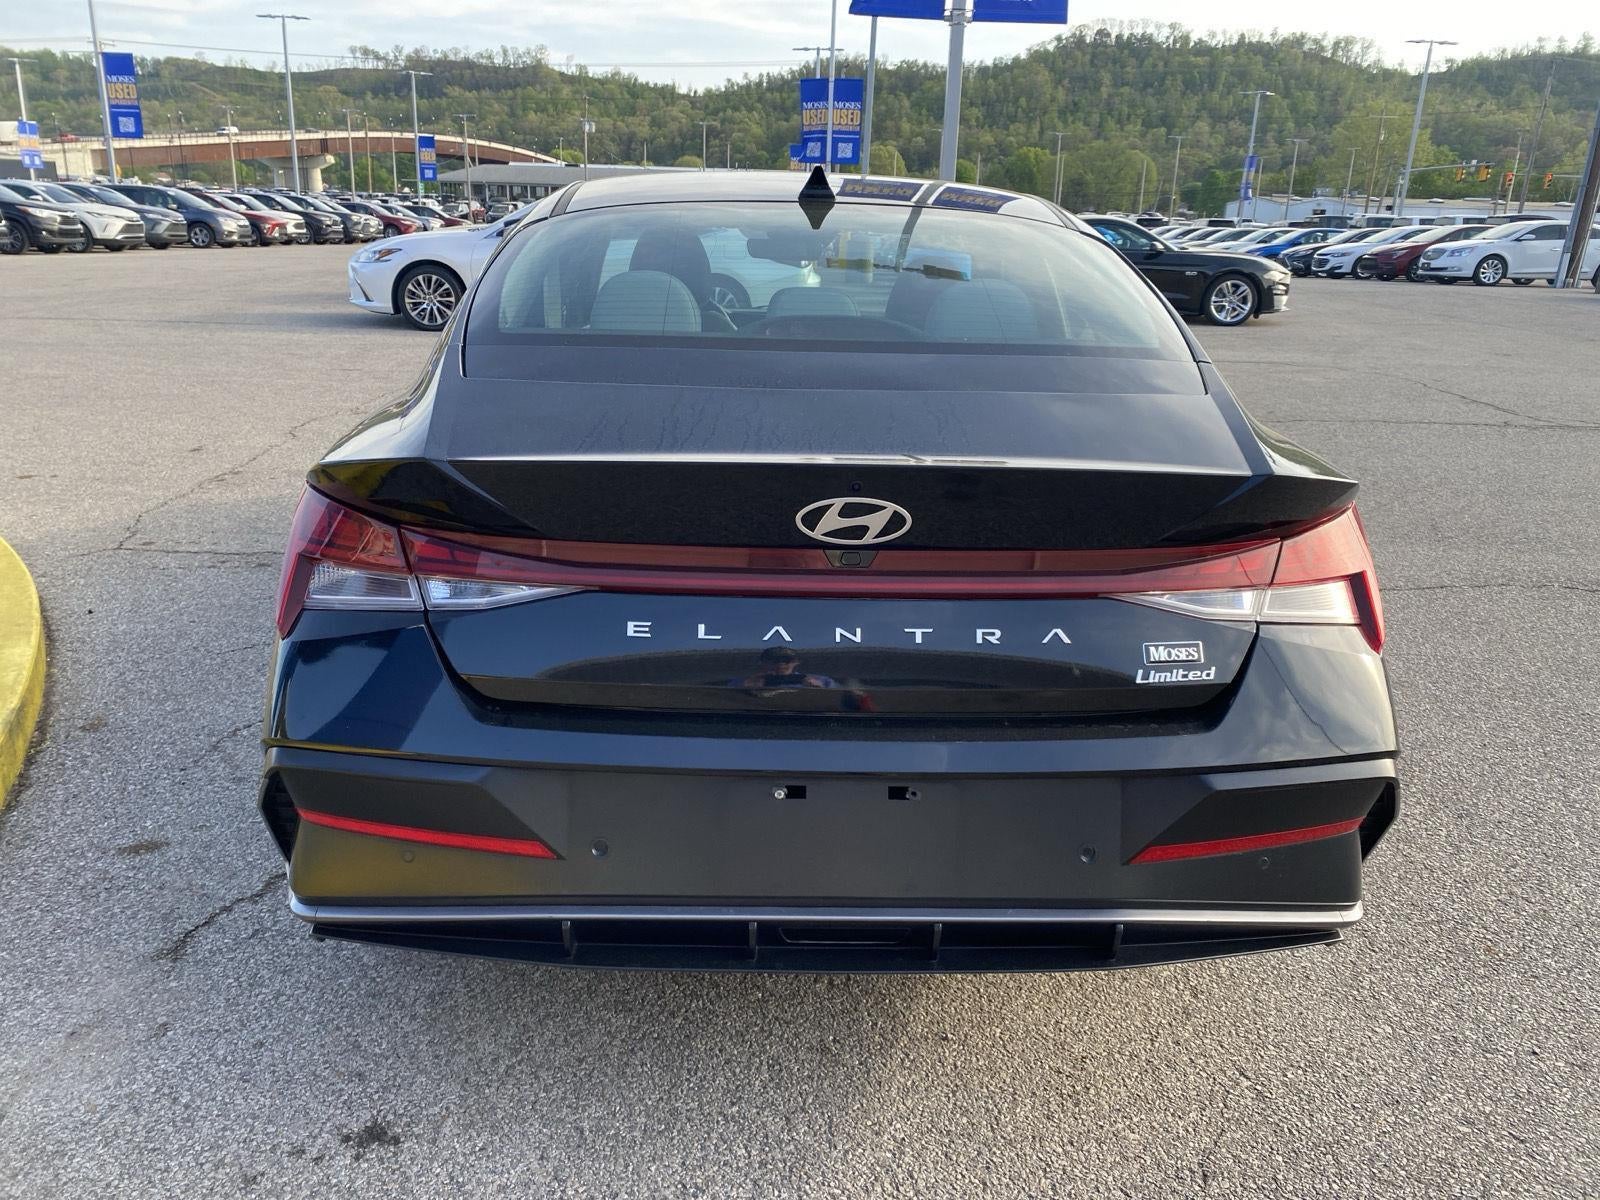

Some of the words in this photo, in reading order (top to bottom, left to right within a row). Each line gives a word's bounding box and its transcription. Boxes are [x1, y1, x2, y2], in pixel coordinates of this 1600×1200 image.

[106, 74, 135, 83] MOSES
[108, 84, 137, 99] USED
[803, 110, 828, 125] USED
[833, 110, 861, 125] USED
[626, 620, 1073, 645] ELANTRA
[1149, 646, 1199, 662] MOSES
[1135, 666, 1216, 684] Limited
